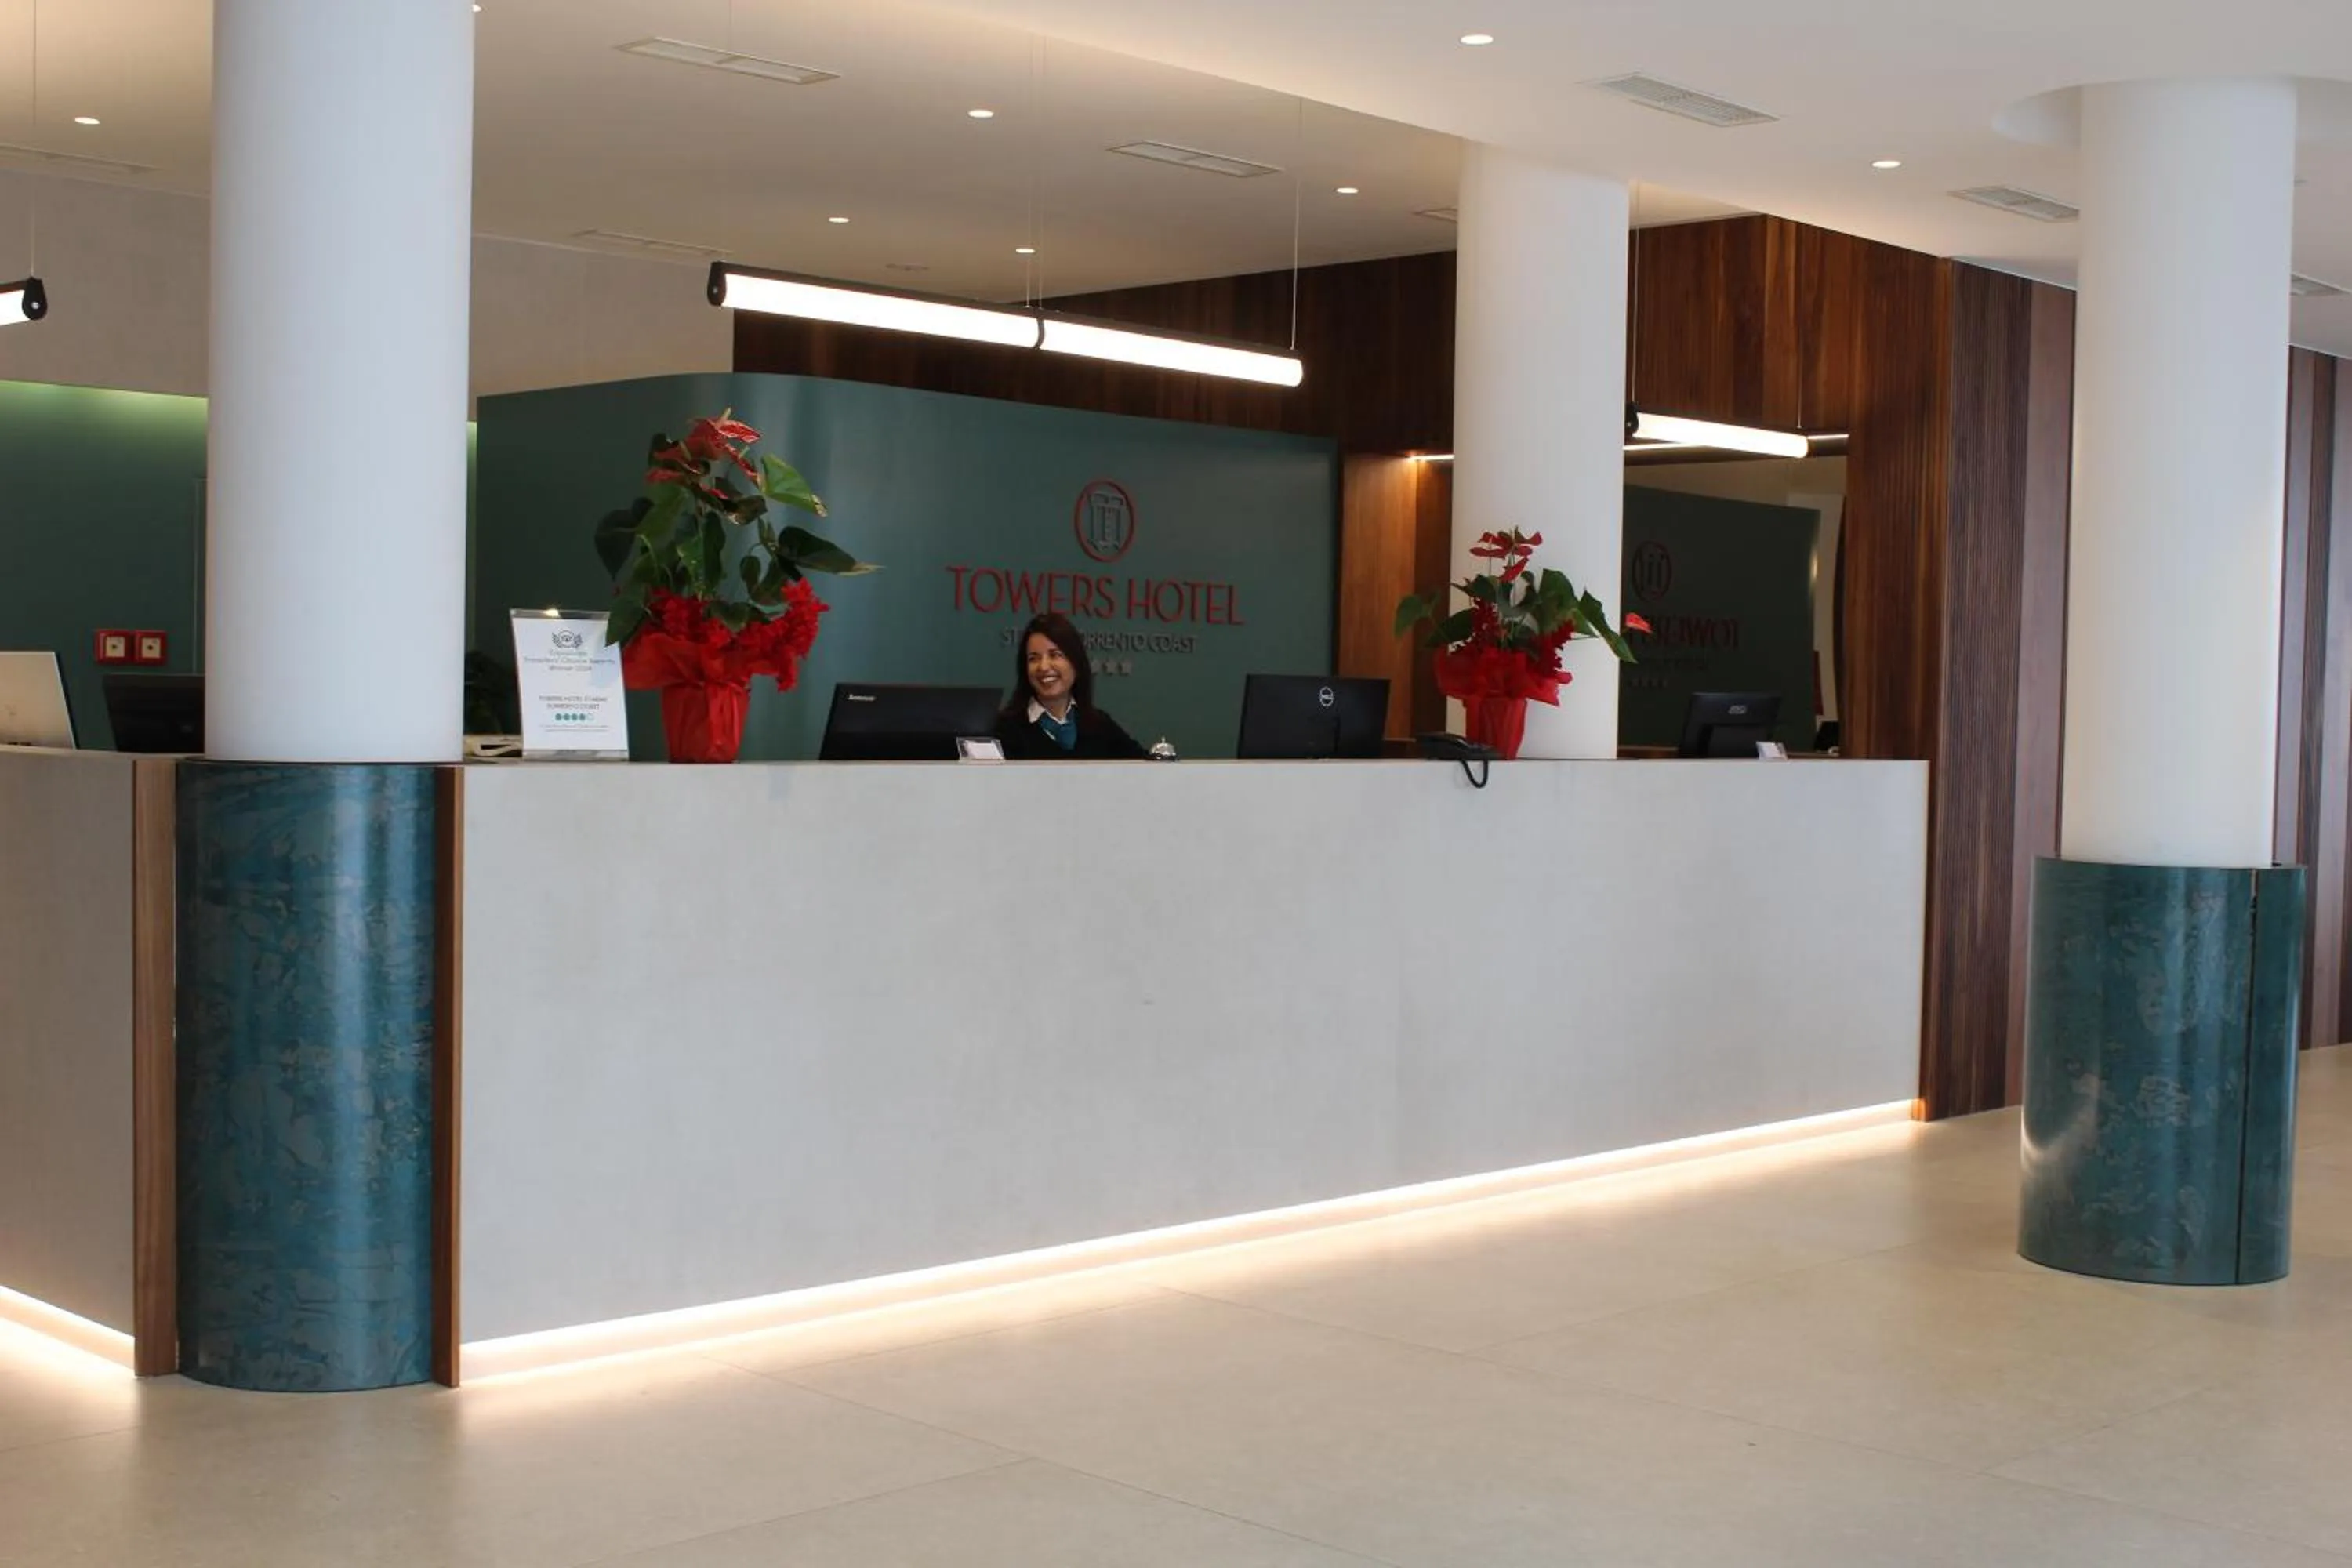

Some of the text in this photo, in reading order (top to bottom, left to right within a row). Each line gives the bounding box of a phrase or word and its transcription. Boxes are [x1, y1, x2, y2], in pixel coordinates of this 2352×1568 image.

[946, 565, 1245, 625] TOWERS HOTEL
[1149, 633, 1199, 654] COAST
